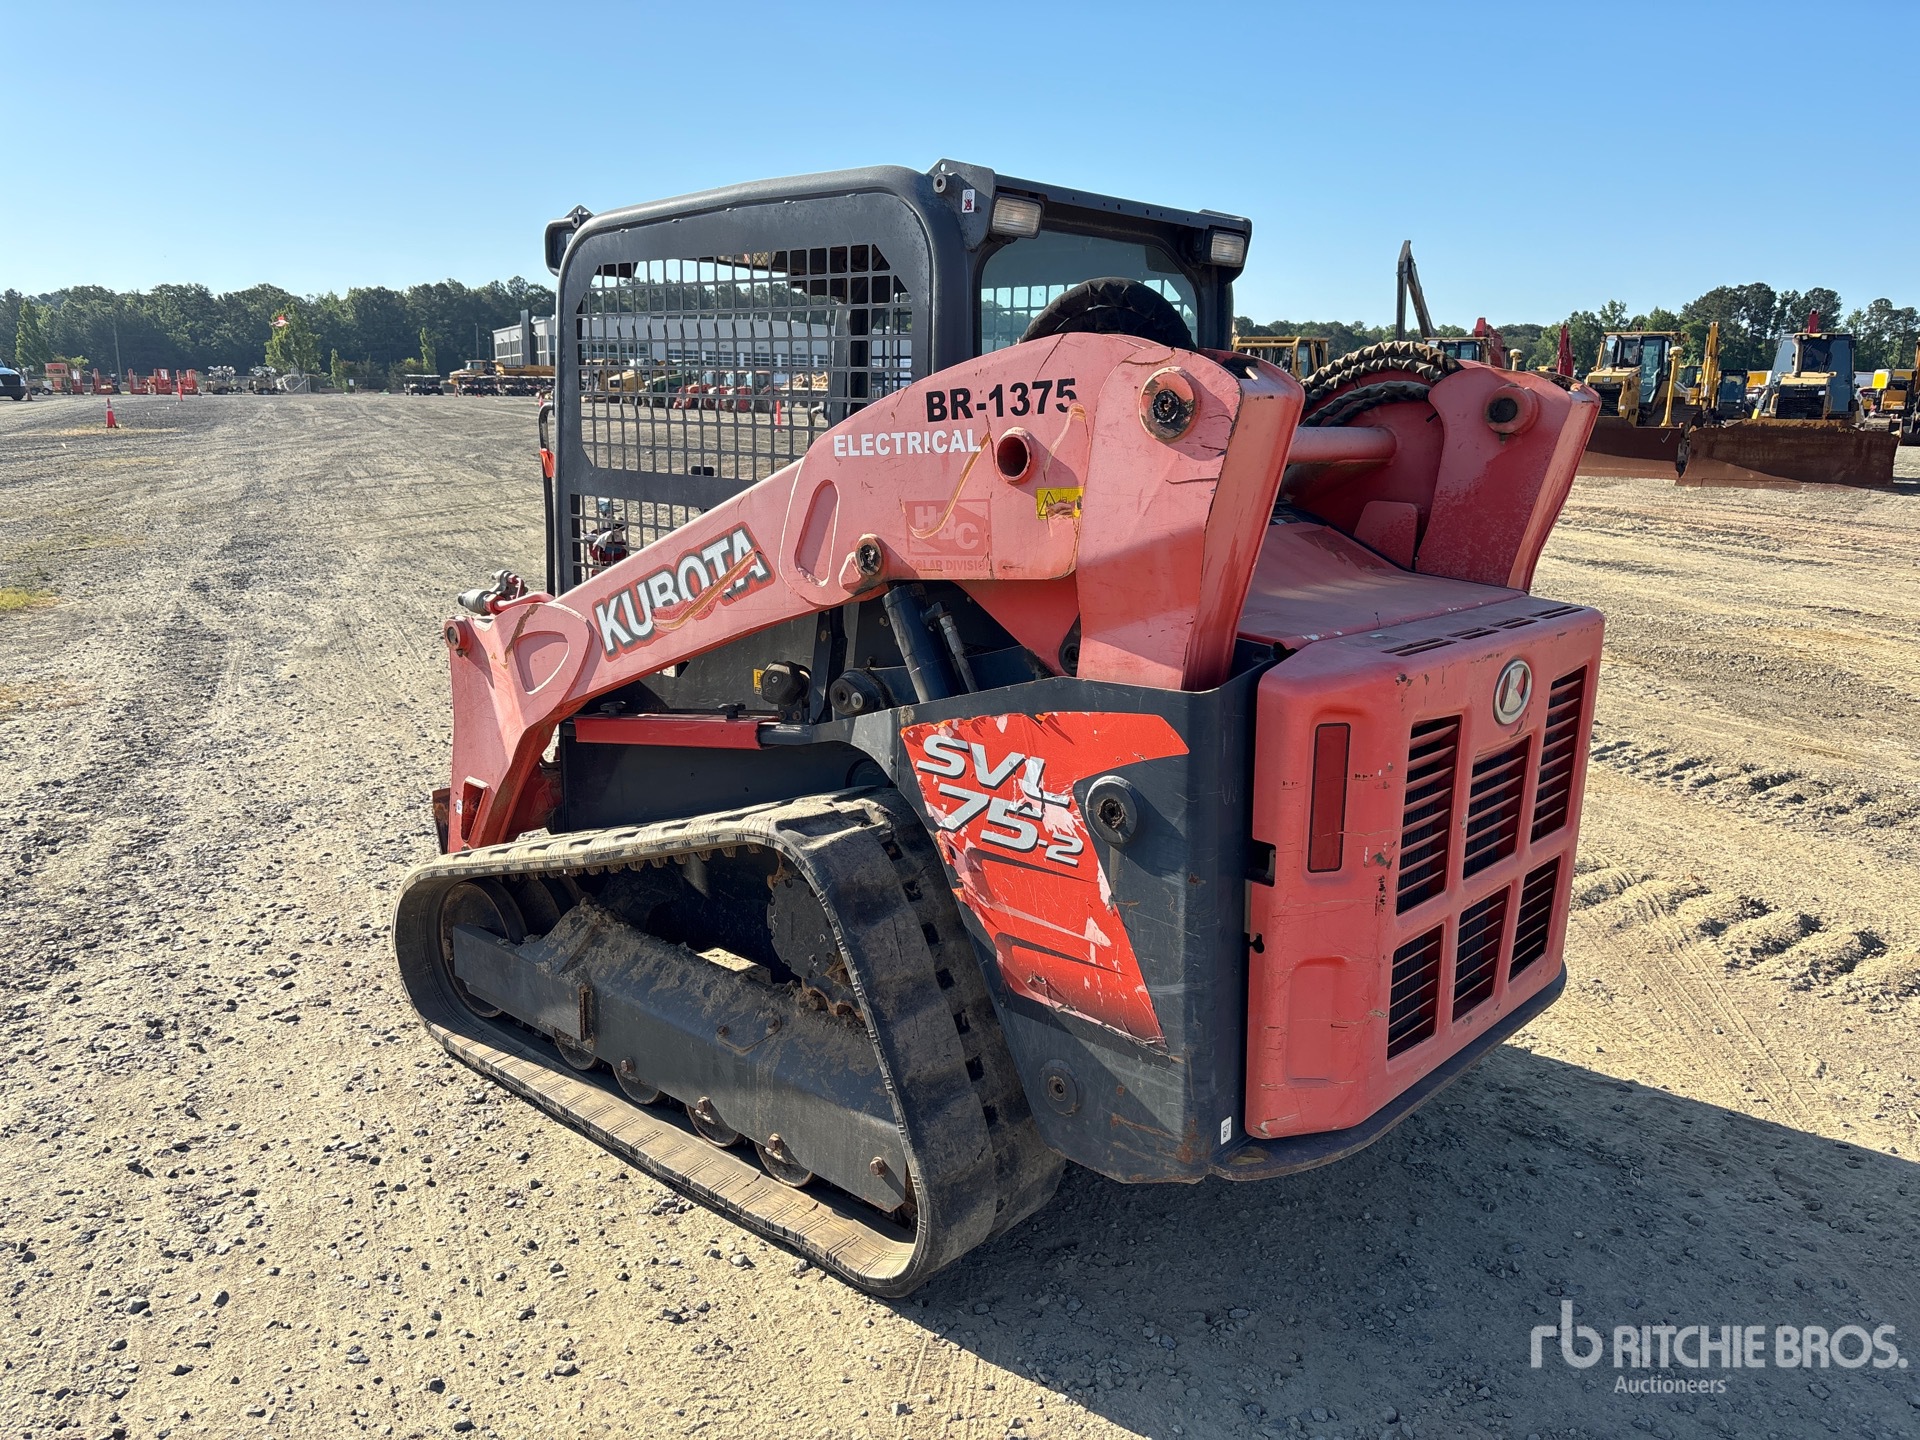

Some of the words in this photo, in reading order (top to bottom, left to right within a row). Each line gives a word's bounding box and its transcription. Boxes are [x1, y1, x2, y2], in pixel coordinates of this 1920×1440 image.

[925, 377, 1079, 423] BR-1375
[833, 428, 982, 457] ELECTRICAL
[595, 528, 767, 652] KUBOTA
[916, 733, 1071, 808] SVL
[937, 783, 1084, 867] 75-2
